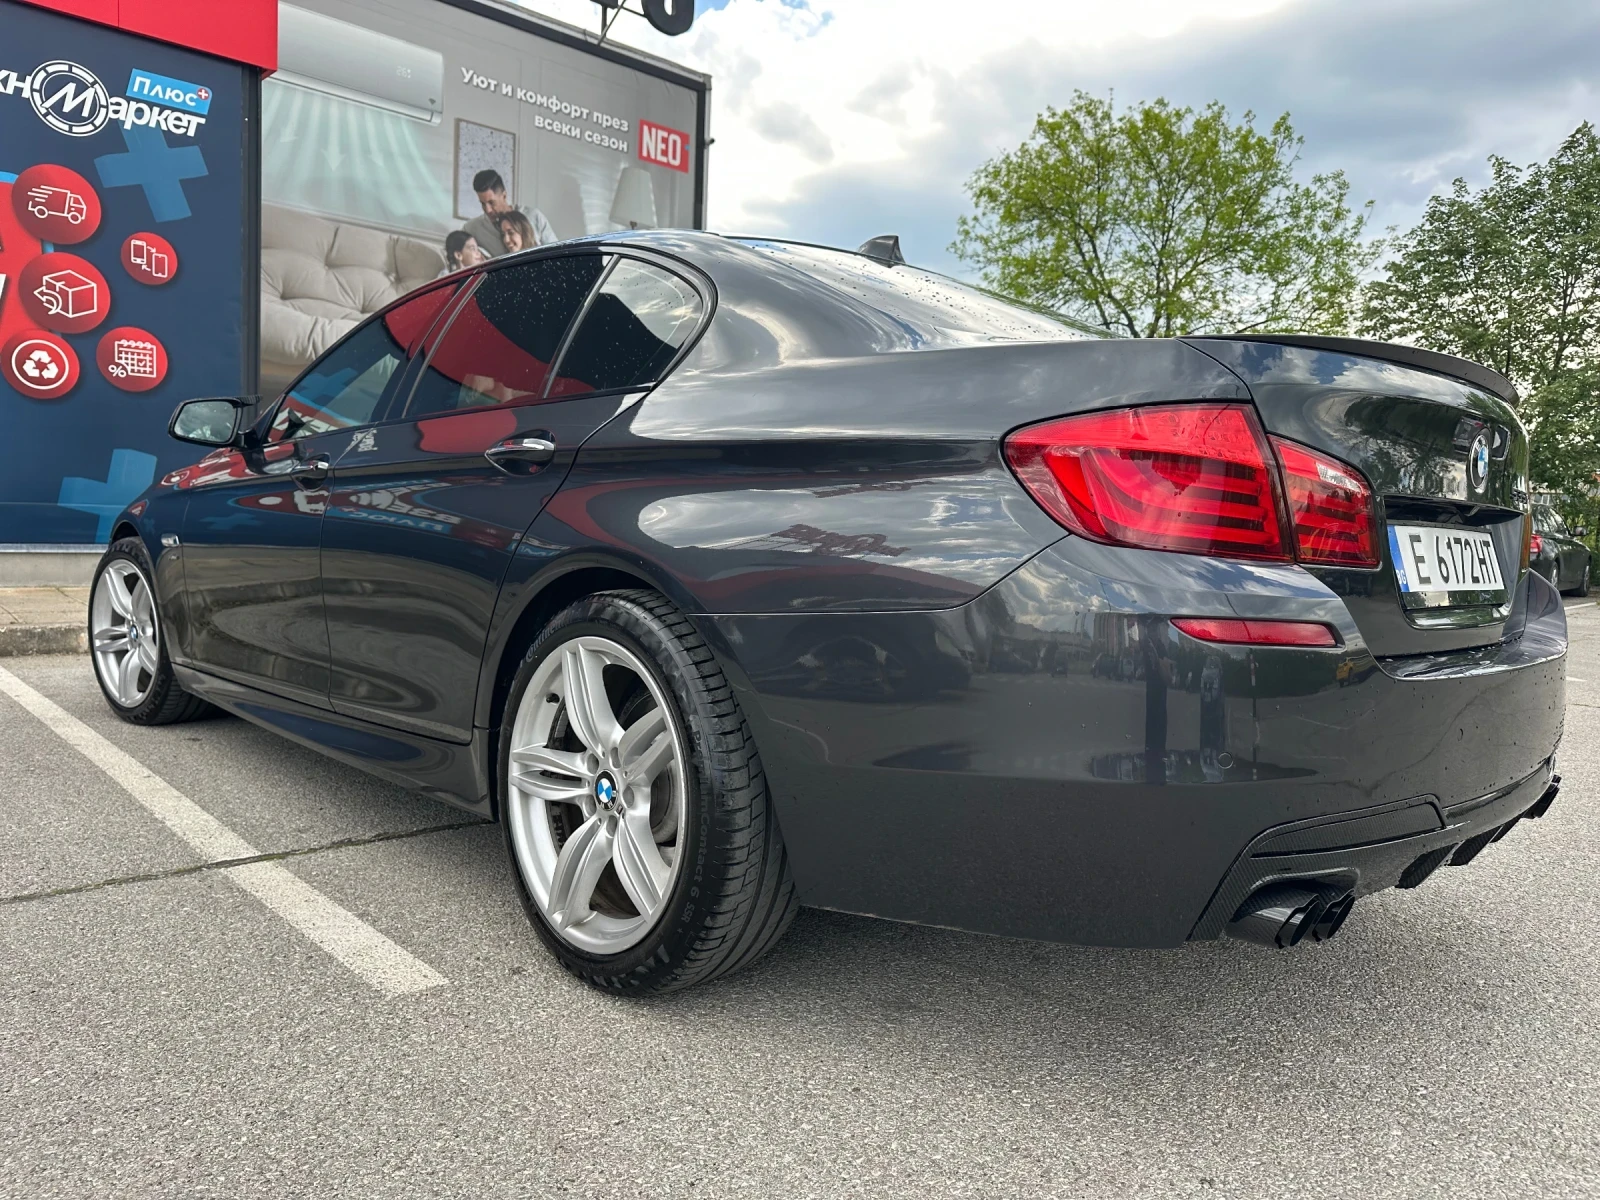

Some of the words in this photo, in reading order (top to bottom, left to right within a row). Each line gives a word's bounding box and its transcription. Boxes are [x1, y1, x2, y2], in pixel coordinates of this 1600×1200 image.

[460, 66, 498, 92] Уют
[501, 82, 513, 97] и
[517, 87, 590, 120] комфорт
[592, 110, 629, 132] през
[534, 114, 581, 139] всеки
[584, 130, 628, 152] сезон
[641, 124, 682, 167] NEO
[1408, 534, 1432, 585] E
